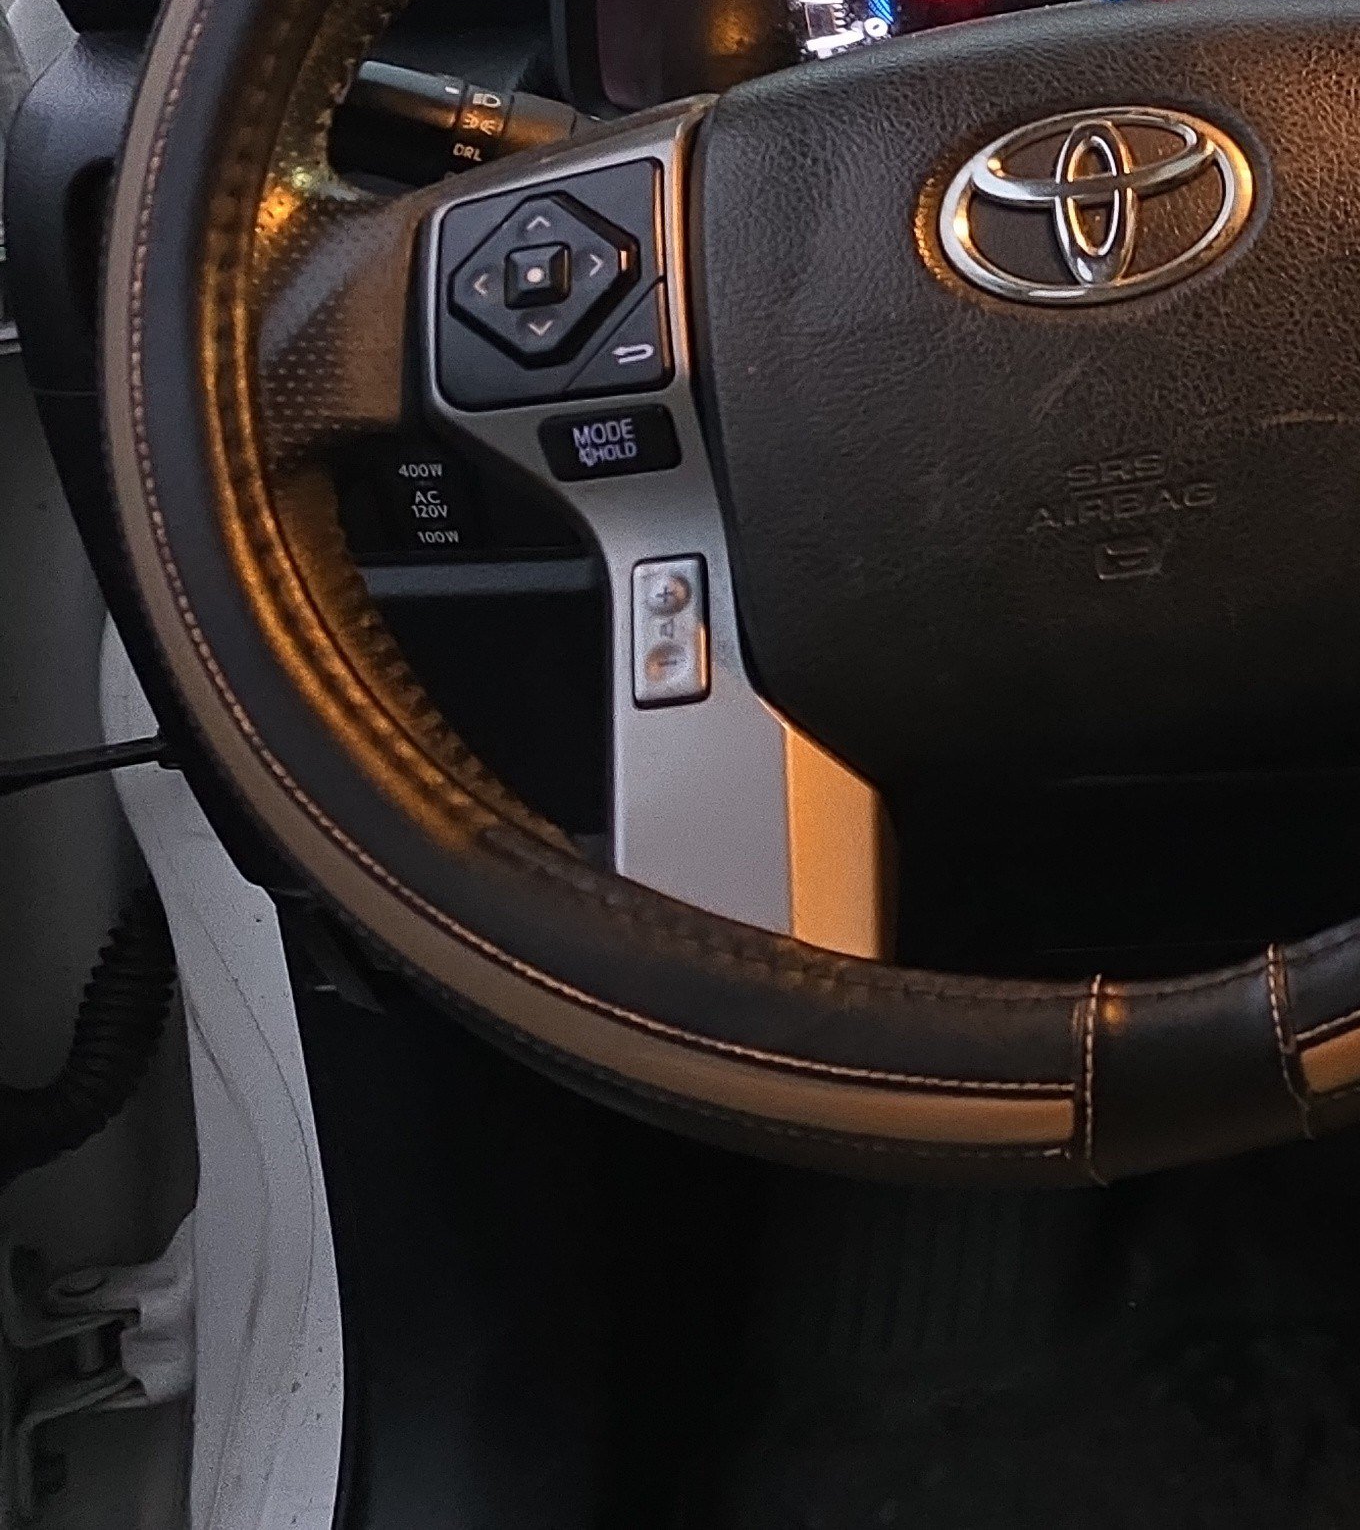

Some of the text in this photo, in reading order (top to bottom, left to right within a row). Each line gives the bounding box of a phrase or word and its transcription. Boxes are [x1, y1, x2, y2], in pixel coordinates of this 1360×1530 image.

[452, 142, 482, 162] DRL
[572, 417, 636, 448] MODE
[597, 441, 637, 462] HOLD
[398, 463, 443, 478] 400W
[1066, 454, 1166, 488] SRS
[415, 490, 441, 504] AC
[1025, 482, 1218, 531] AIRBAG
[411, 505, 448, 518] 120V
[416, 531, 459, 543] 100W
